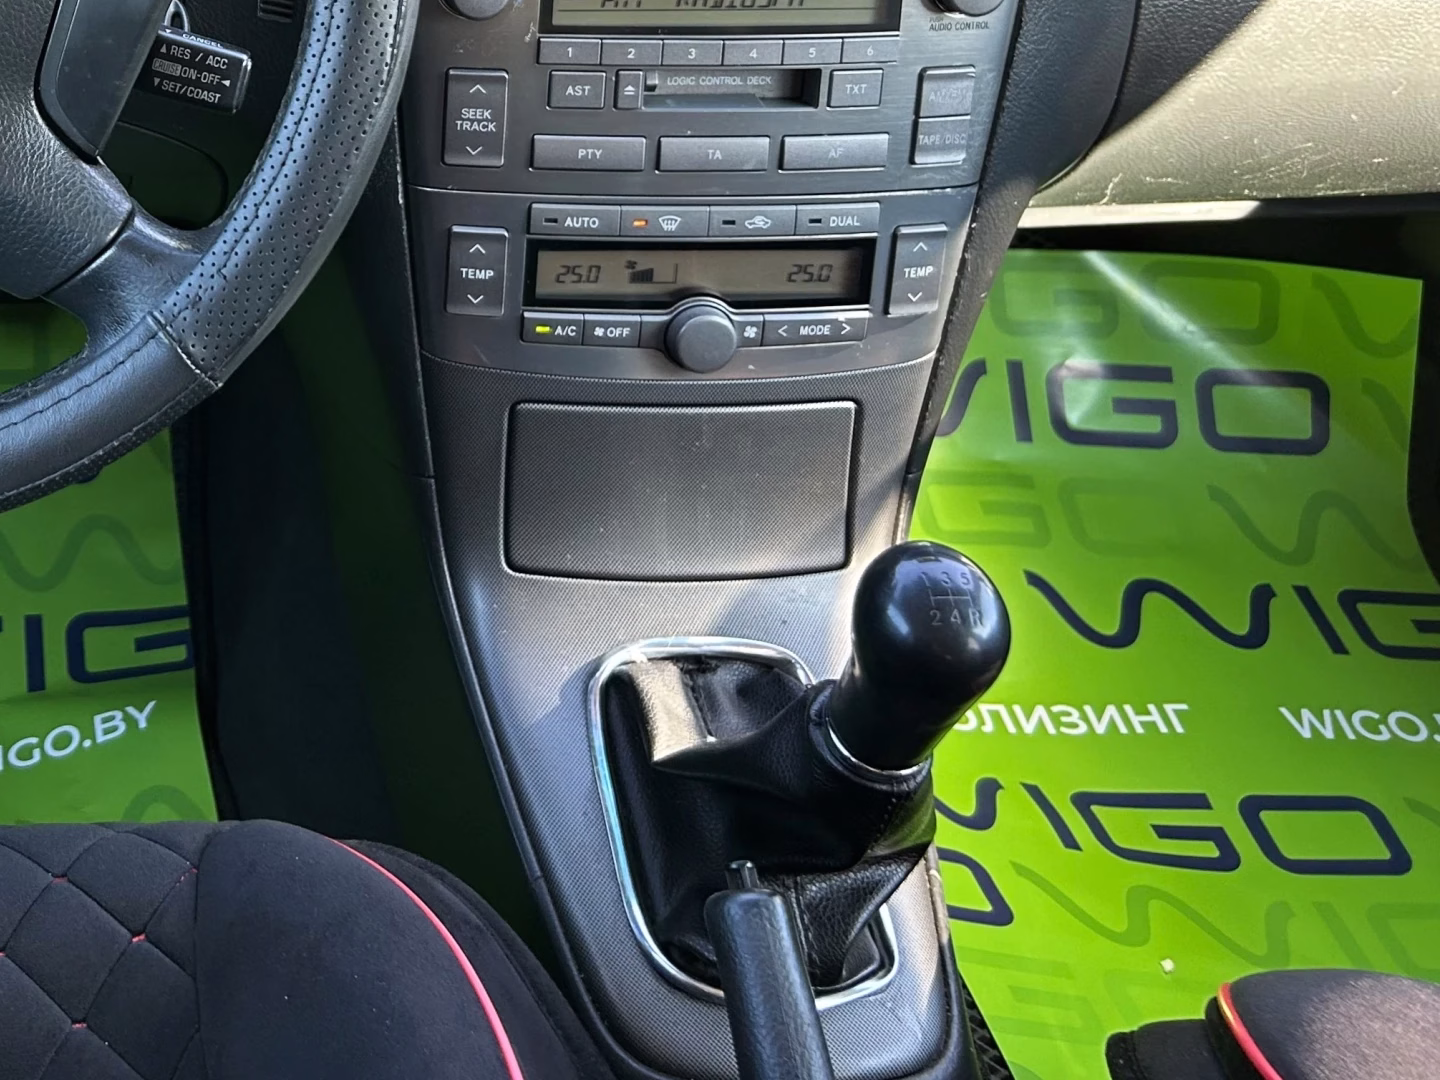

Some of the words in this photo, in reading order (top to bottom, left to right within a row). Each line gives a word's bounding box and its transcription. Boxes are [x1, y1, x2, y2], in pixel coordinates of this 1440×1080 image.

[929, 22, 952, 31] AUDIO
[955, 21, 989, 30] CONTROL
[182, 34, 223, 48] CANCEL
[170, 45, 191, 59] RES
[205, 55, 228, 69] ACC
[568, 48, 572, 58] 1
[628, 48, 635, 58] 2
[688, 48, 696, 58] 3
[749, 48, 758, 58] 4
[808, 48, 816, 58] 5
[867, 46, 874, 56] 6
[181, 66, 221, 85] ON-OFF
[667, 76, 696, 86] LOGIC
[699, 75, 743, 86] CONTROL
[747, 74, 772, 85] DECK
[162, 80, 221, 103] SET/COAST
[566, 86, 590, 96] AST
[845, 84, 867, 94] TXT
[461, 108, 492, 119] SEEK
[456, 121, 496, 132] TRACK
[919, 134, 966, 145] TAPE/DISC
[578, 149, 602, 159] PTY
[708, 150, 722, 160] TA
[828, 148, 842, 158] AF
[564, 217, 599, 228] AUTO
[830, 216, 860, 226] DUAL
[461, 268, 494, 279] TEMP
[555, 265, 601, 284] 25.0
[787, 264, 833, 283] 25.0
[904, 266, 933, 277] TEMP
[554, 326, 577, 336] A/C
[607, 327, 630, 337] OFF
[799, 325, 831, 335] MODE
[930, 610, 942, 625] 2
[951, 608, 961, 624] 4
[969, 608, 983, 627] R
[953, 703, 1188, 735] ОЛИЗИНГ
[1278, 706, 1440, 742] WIGO.
